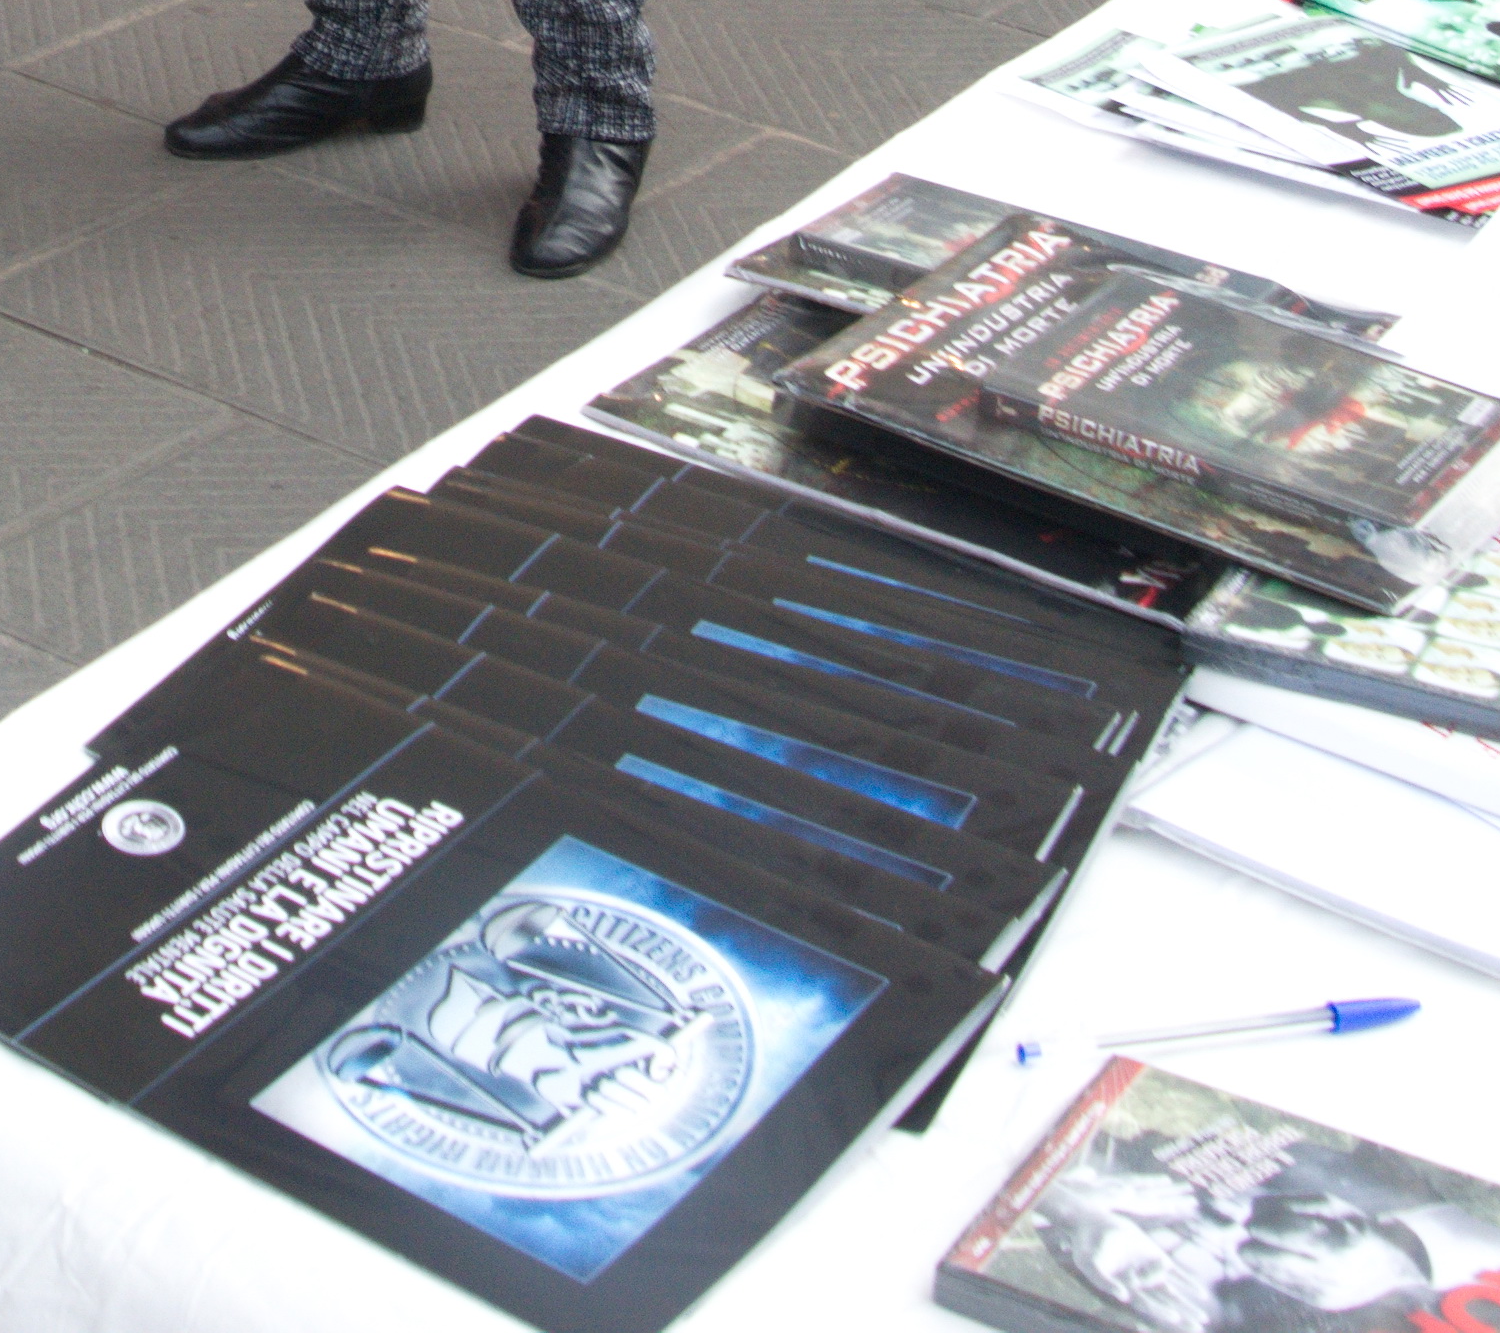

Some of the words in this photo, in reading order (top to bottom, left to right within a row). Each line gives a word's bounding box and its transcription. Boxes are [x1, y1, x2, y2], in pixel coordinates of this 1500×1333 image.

[824, 222, 1072, 391] PSICHIATRIA
[995, 296, 1081, 358] MORTE
[1037, 293, 1181, 401] PSICHIATRIA
[1037, 404, 1201, 476] PSICHIATRIA
[286, 812, 356, 857] CAMPO
[308, 796, 418, 877] UMANI
[242, 851, 305, 893] DELLA
[272, 800, 466, 947] RIPRISTINARE
[284, 868, 332, 895] E
[189, 887, 259, 934] SALUTE
[240, 884, 310, 928] LA
[119, 927, 204, 986] MENTALE
[255, 939, 293, 960] I
[571, 905, 708, 985] CITIZENS
[156, 950, 280, 1036] DIRITTI
[349, 1088, 491, 1173] RIGHTS
